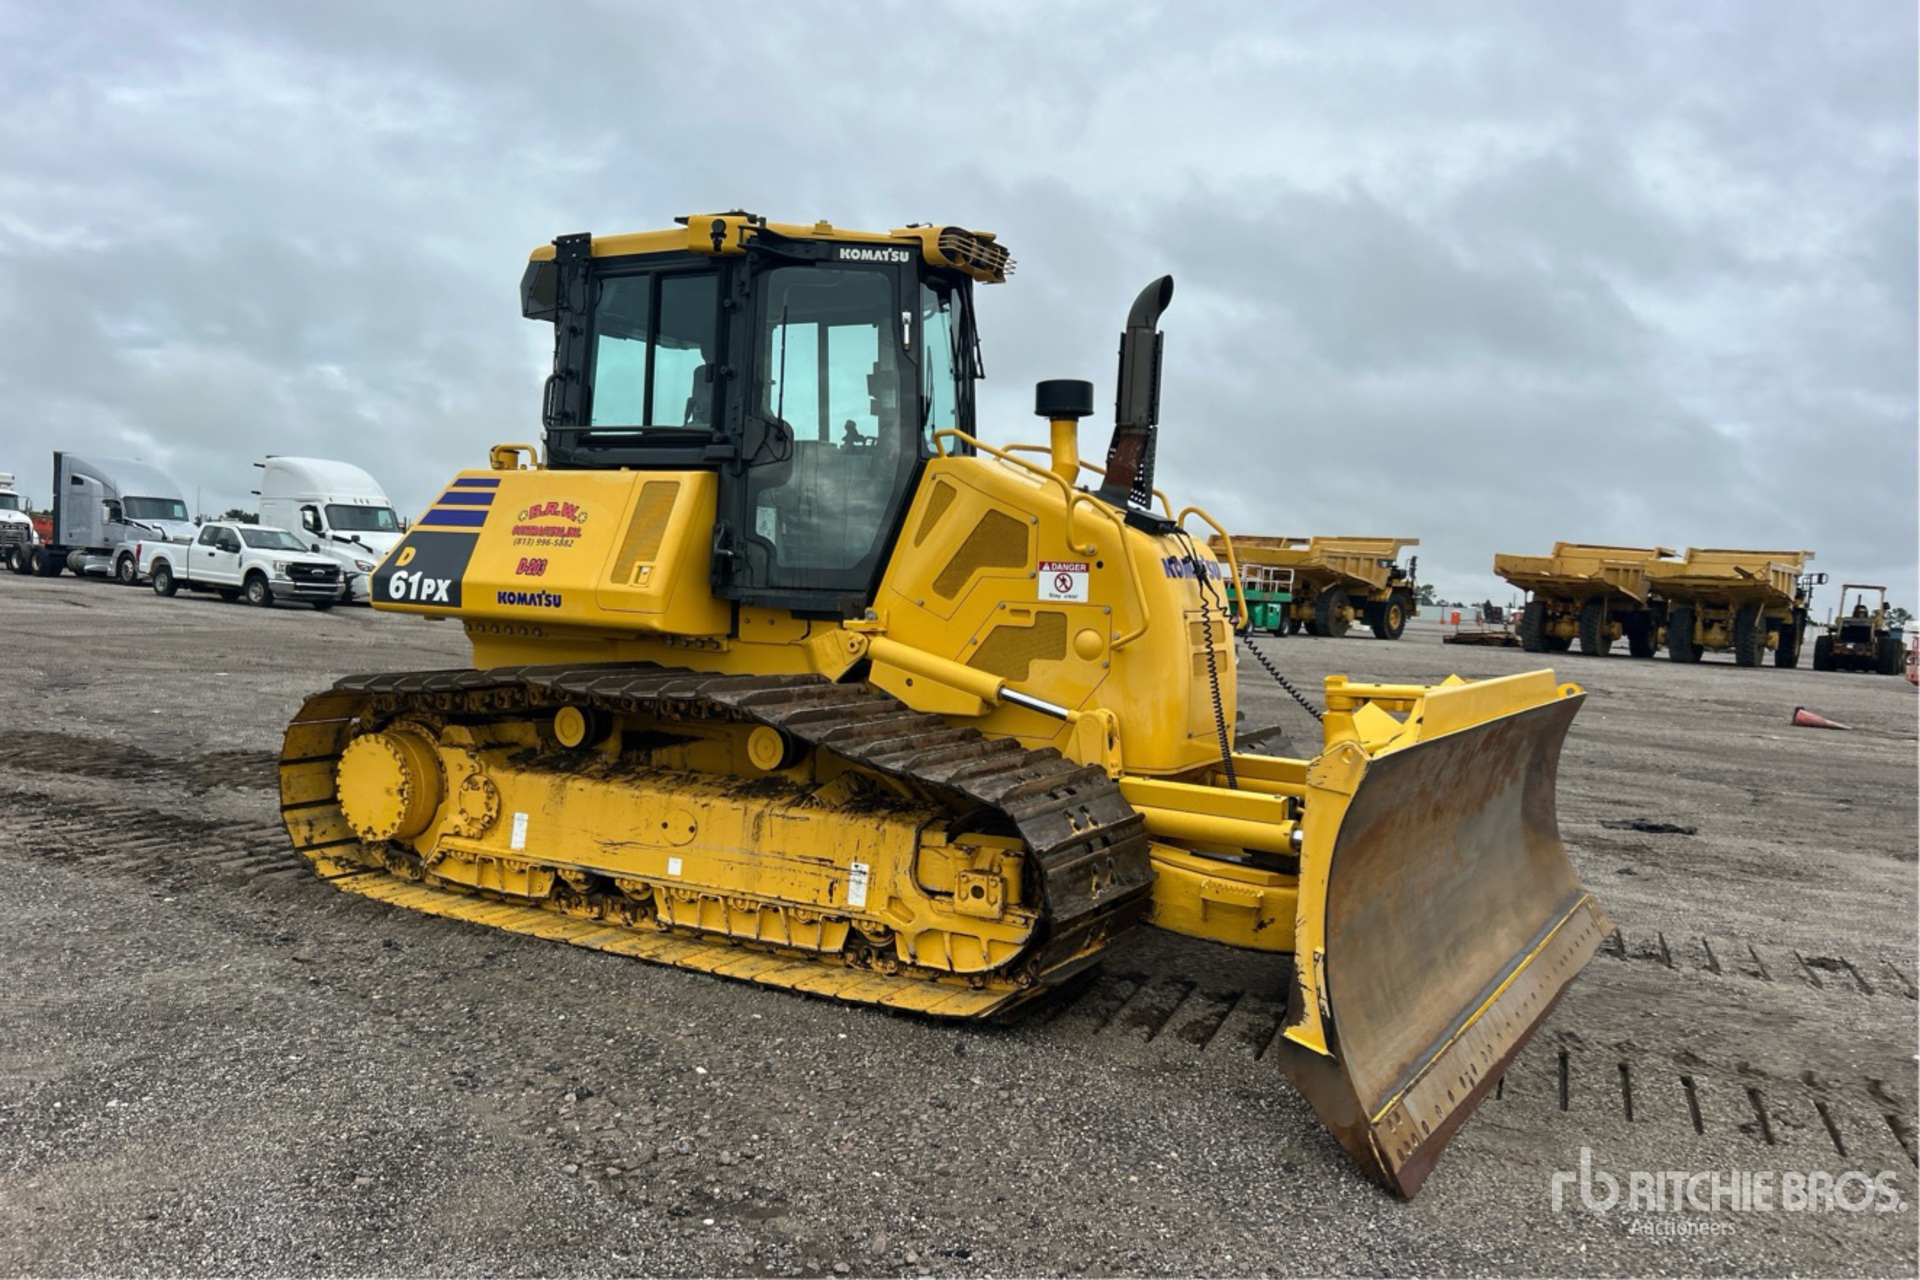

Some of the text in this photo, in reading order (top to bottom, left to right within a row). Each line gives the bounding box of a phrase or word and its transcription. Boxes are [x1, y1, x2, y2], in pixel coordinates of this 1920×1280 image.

[840, 248, 909, 262] KOMATSU
[513, 538, 535, 546] (813)
[395, 546, 416, 567] D
[1051, 563, 1086, 572] DANGER
[388, 569, 452, 602] 61PX
[497, 589, 562, 608] KOMATSU
